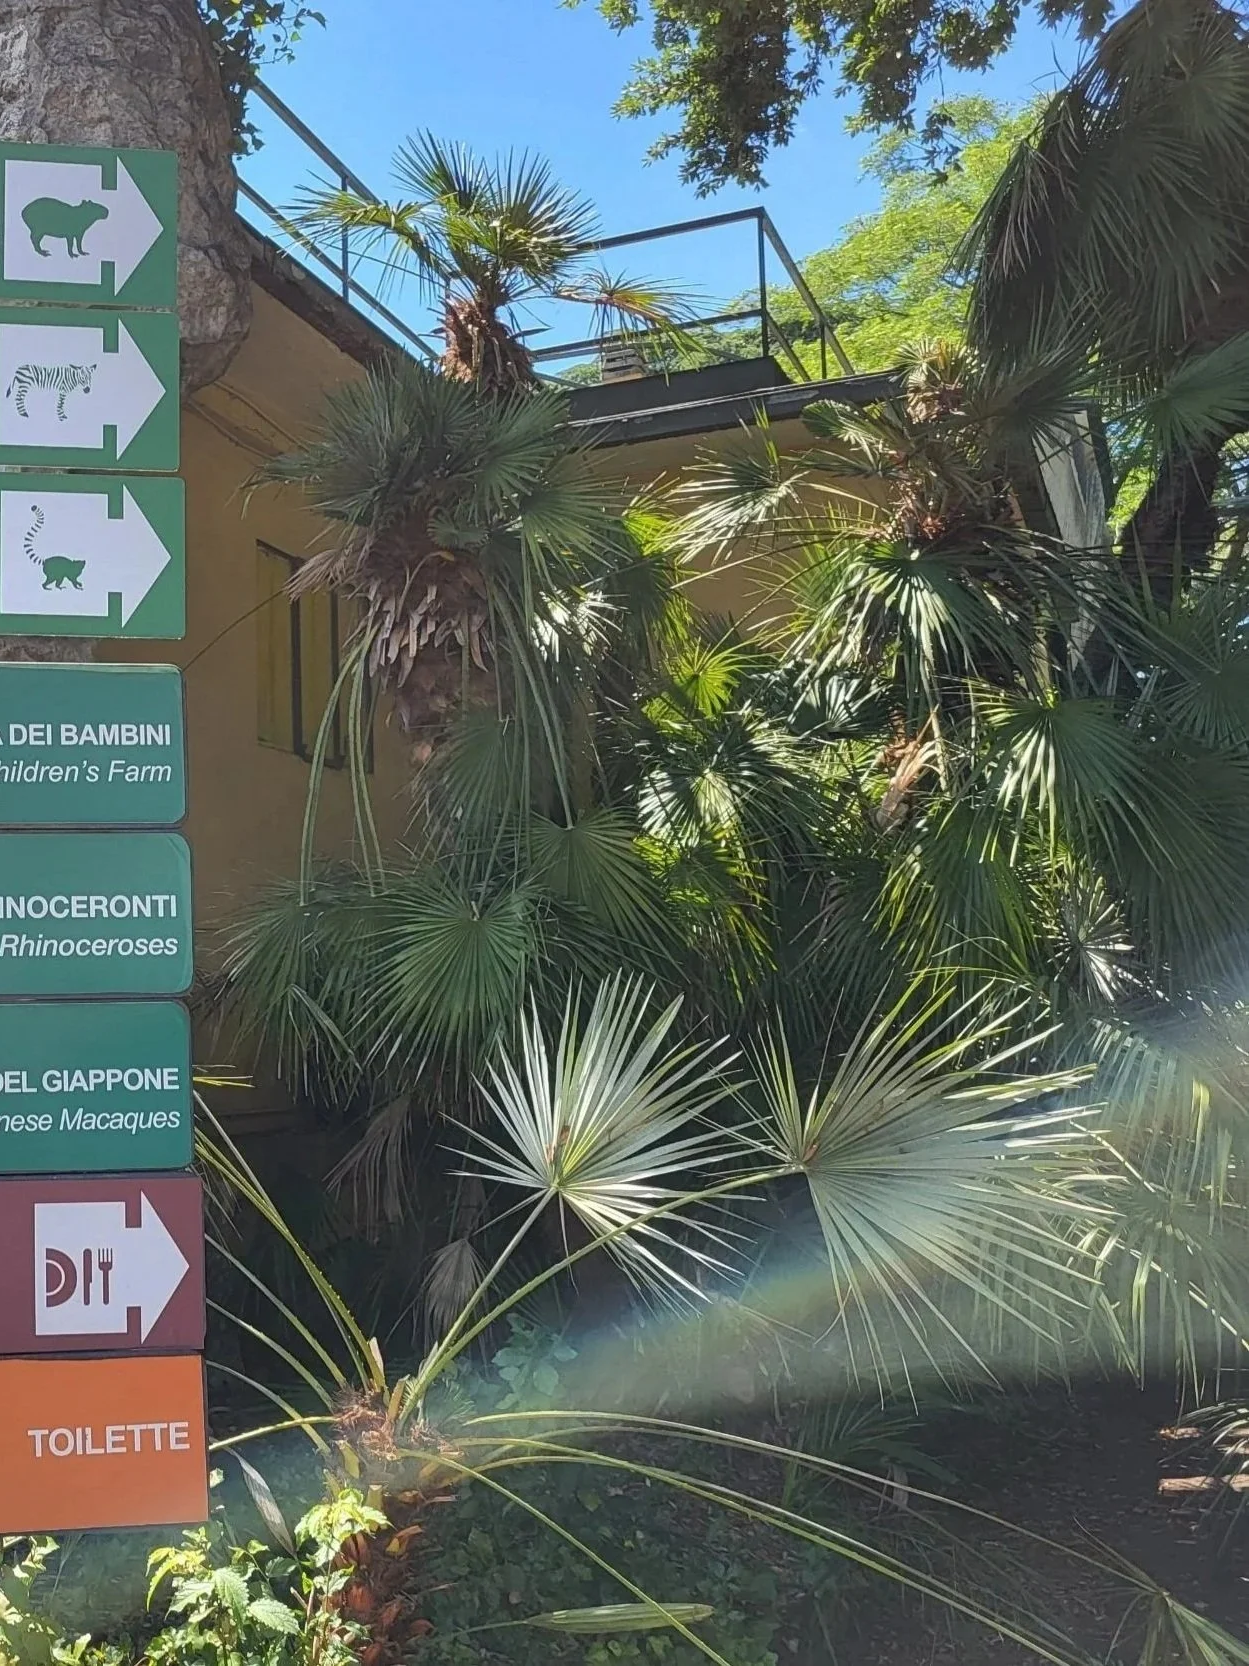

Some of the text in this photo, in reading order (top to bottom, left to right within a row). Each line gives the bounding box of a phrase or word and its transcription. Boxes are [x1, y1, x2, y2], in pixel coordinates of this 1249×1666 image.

[8, 724, 52, 746] DEI
[60, 724, 170, 746] BAMBINI
[108, 760, 172, 782] Farm
[0, 934, 178, 957] Rhinoceroses
[42, 1068, 179, 1092] GIAPPONE
[59, 1107, 180, 1134] Macaques
[28, 1421, 189, 1457] TOILETTE
